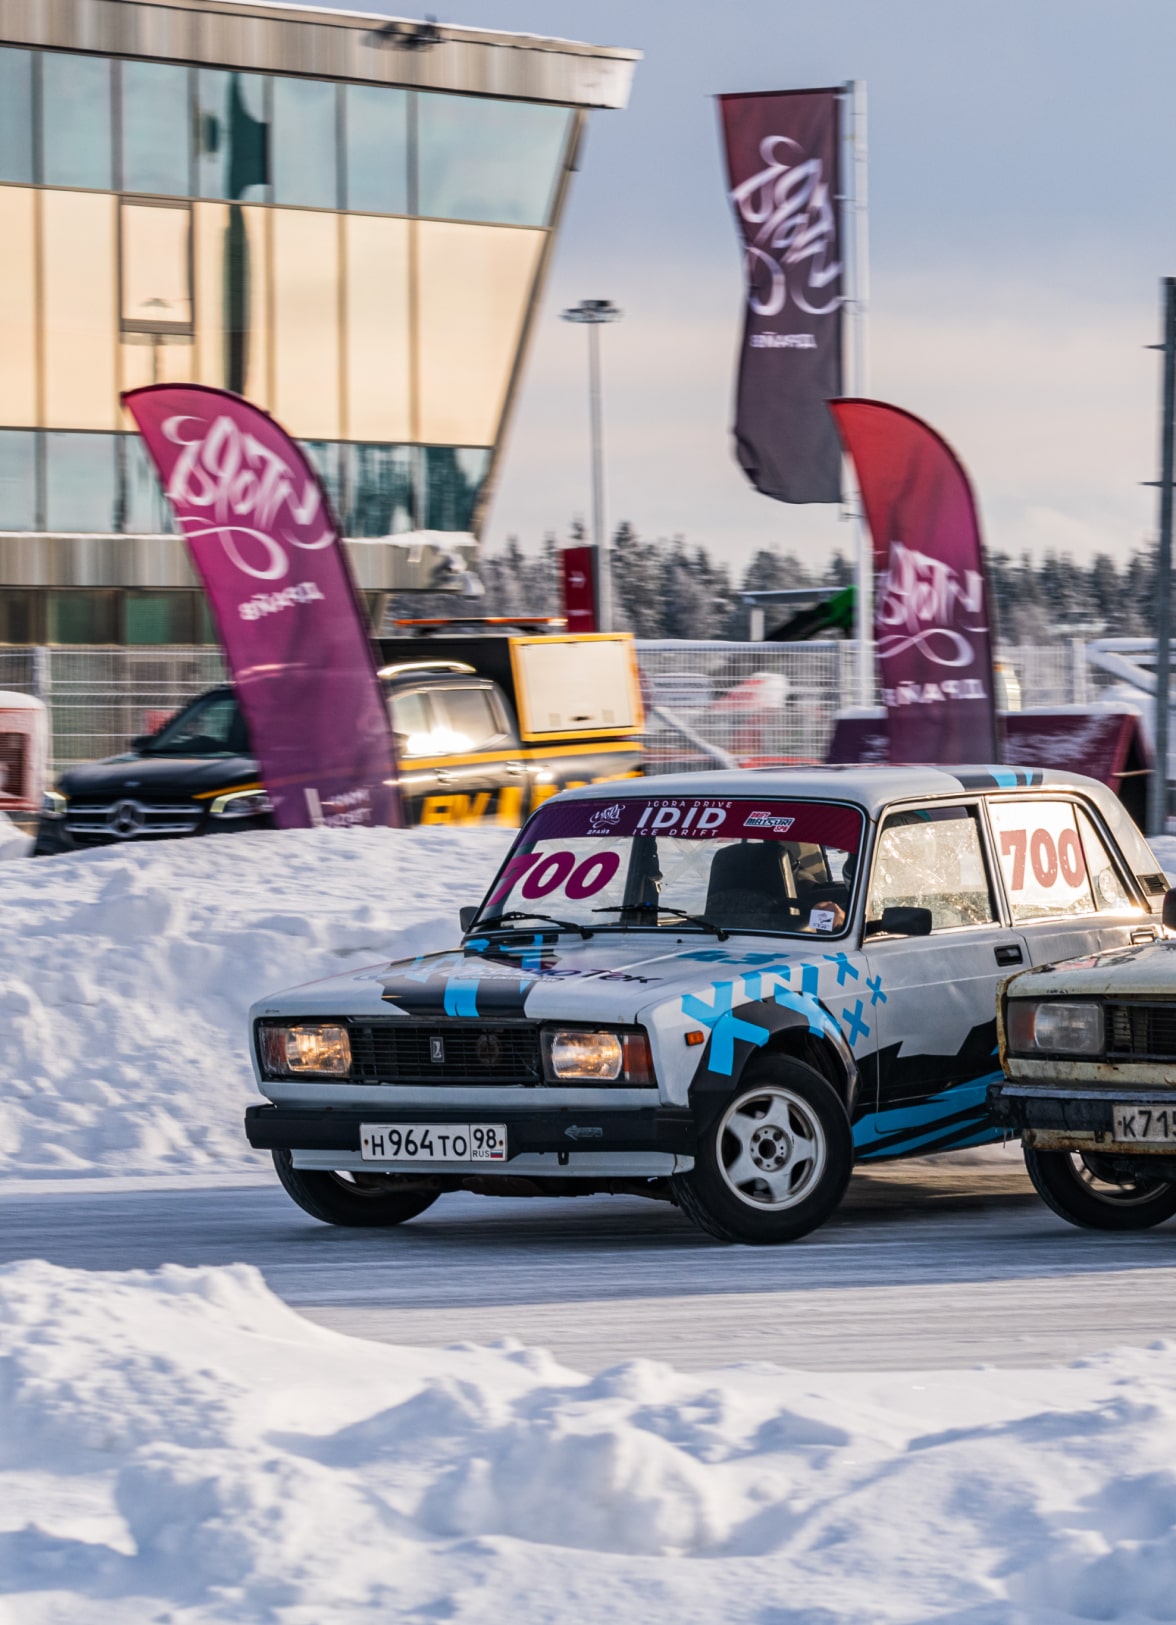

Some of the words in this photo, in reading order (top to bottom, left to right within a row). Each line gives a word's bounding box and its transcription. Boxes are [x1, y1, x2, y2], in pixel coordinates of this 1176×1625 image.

[693, 801, 733, 809] DRIVE
[636, 807, 726, 828] IDID
[632, 828, 659, 836] ICE
[1000, 828, 1085, 891] 700
[486, 851, 620, 907] 700
[472, 1128, 497, 1149] 98
[472, 1150, 490, 1158] RUS
